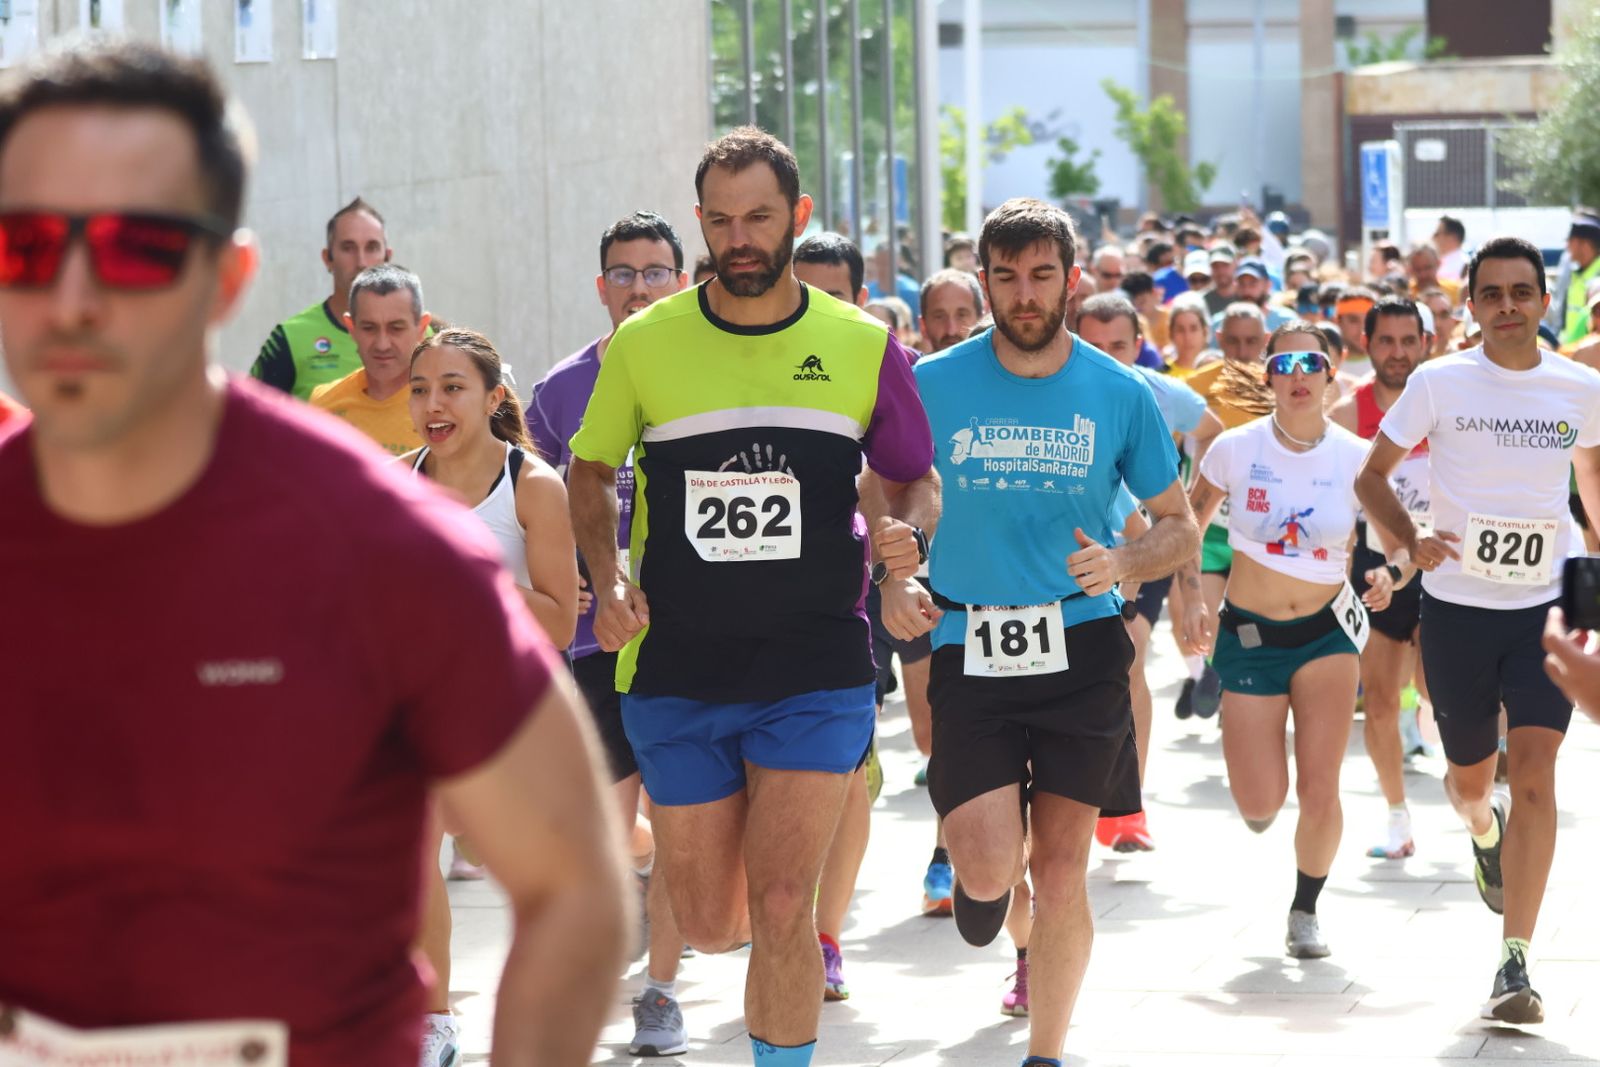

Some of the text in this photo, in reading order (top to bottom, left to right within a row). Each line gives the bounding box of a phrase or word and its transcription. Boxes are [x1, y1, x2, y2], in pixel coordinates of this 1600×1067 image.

[1455, 416, 1569, 435] SANMAXIMO
[984, 427, 1090, 447] BOMBEROS
[1494, 433, 1562, 449] TELECOM
[1025, 442, 1090, 463] de MADRID
[984, 458, 1088, 478] HospitalSanRafael
[690, 477, 705, 488] DÍA
[706, 480, 718, 488] DE
[720, 477, 760, 487] CASTILLA
[769, 476, 794, 484] LEÓN
[1247, 487, 1267, 501] BCN
[1245, 500, 1271, 514] RUNS
[696, 494, 793, 540] 262
[1485, 519, 1496, 527] DE
[1497, 521, 1532, 530] CASTILLA
[1476, 529, 1544, 567] 820
[974, 616, 1051, 658] 181
